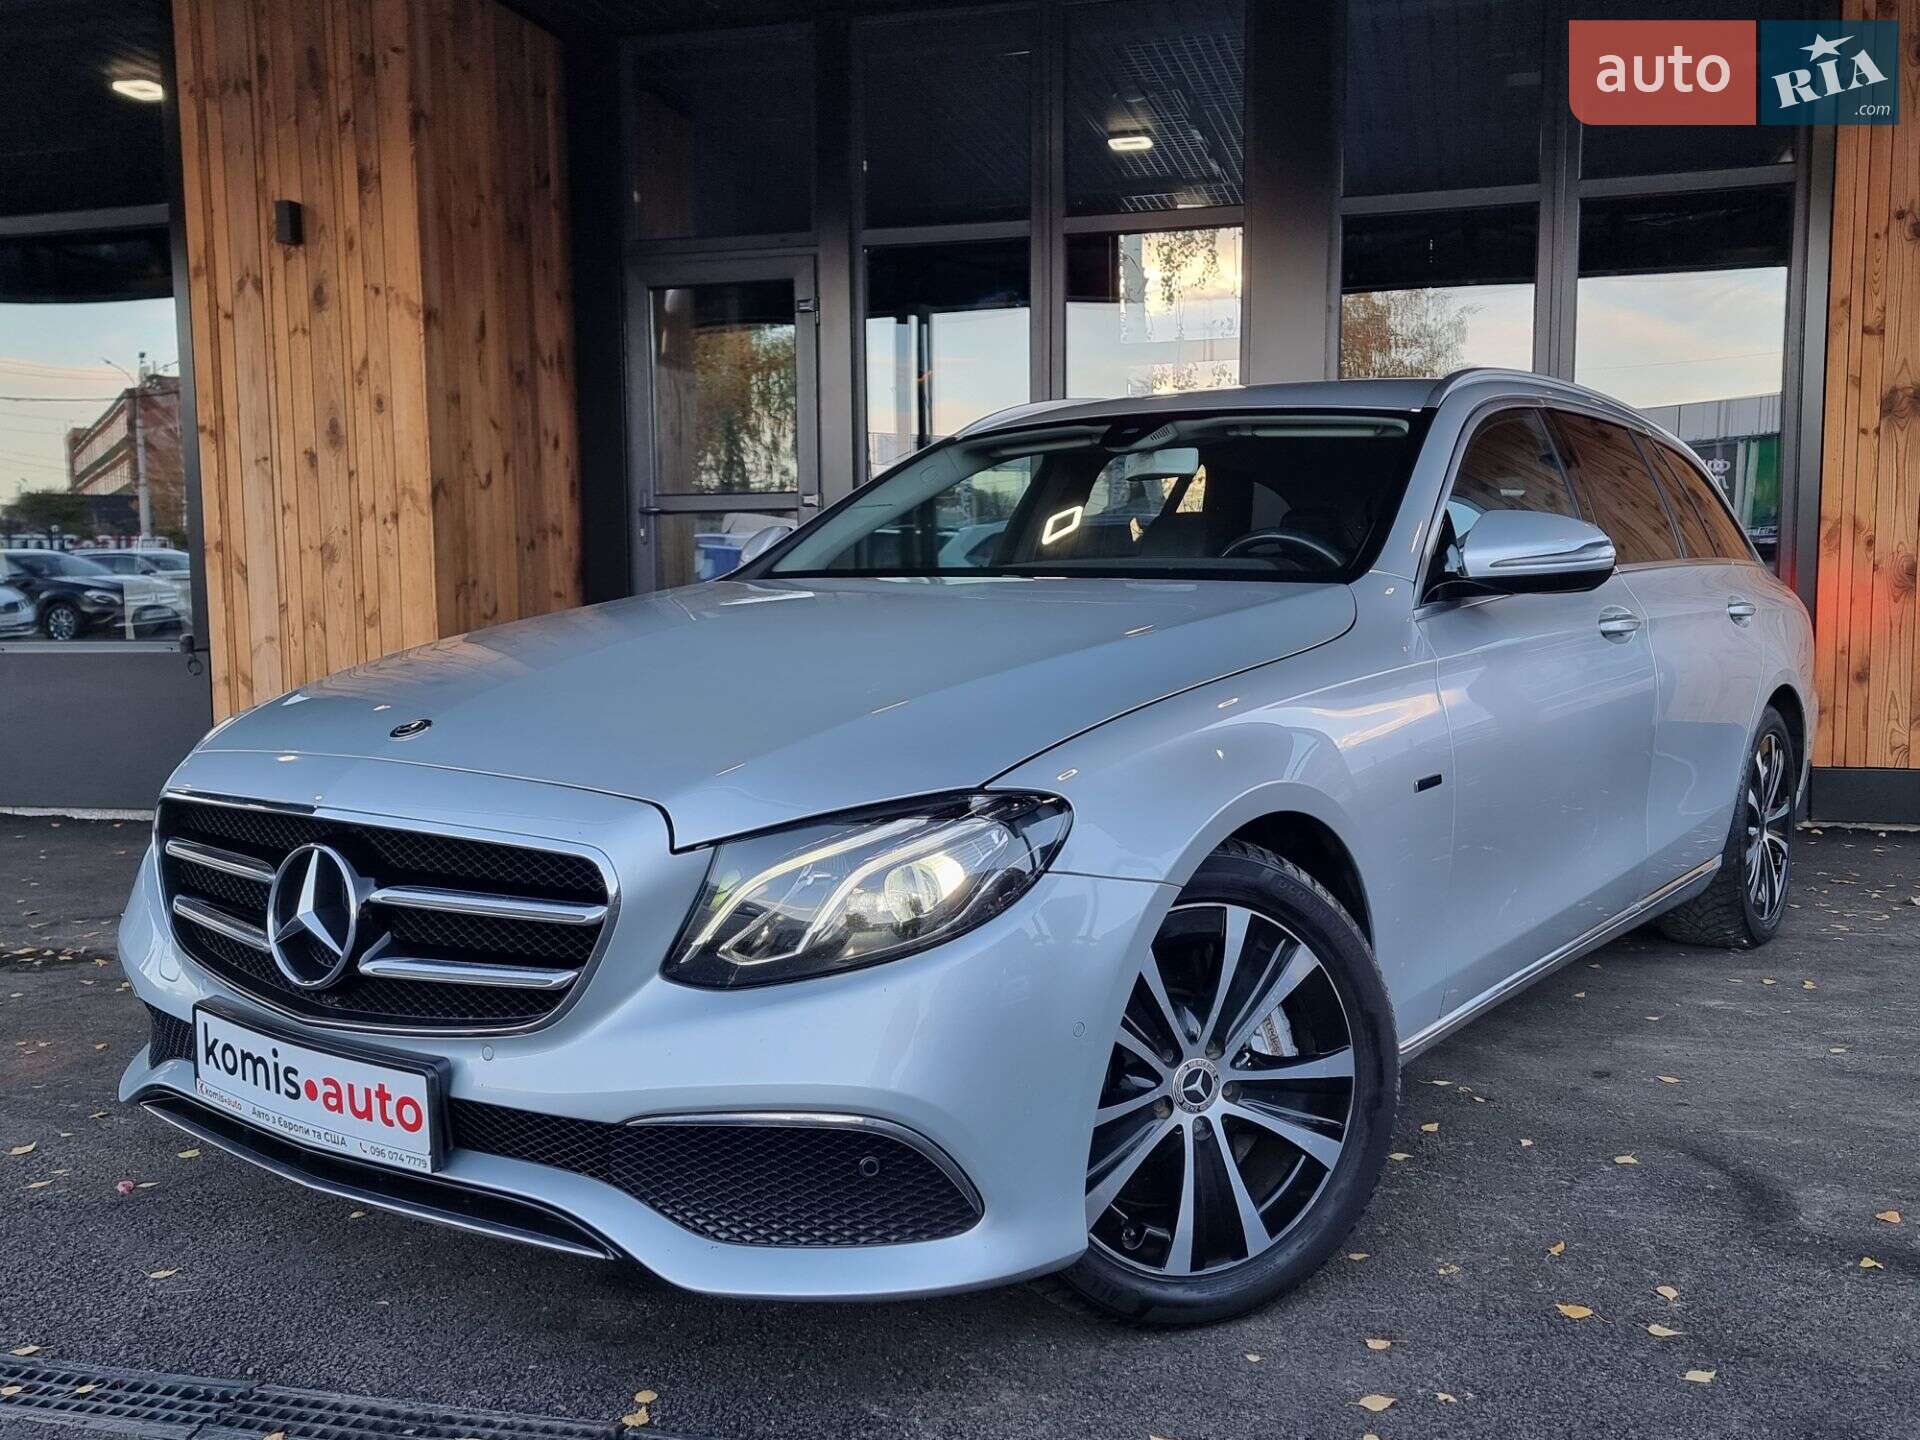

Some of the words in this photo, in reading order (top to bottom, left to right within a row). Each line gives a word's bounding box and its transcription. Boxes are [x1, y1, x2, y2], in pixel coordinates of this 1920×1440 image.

[252, 1107, 270, 1121] Авто
[278, 1117, 310, 1136] Європи
[312, 1129, 322, 1138] та
[324, 1131, 348, 1147] США
